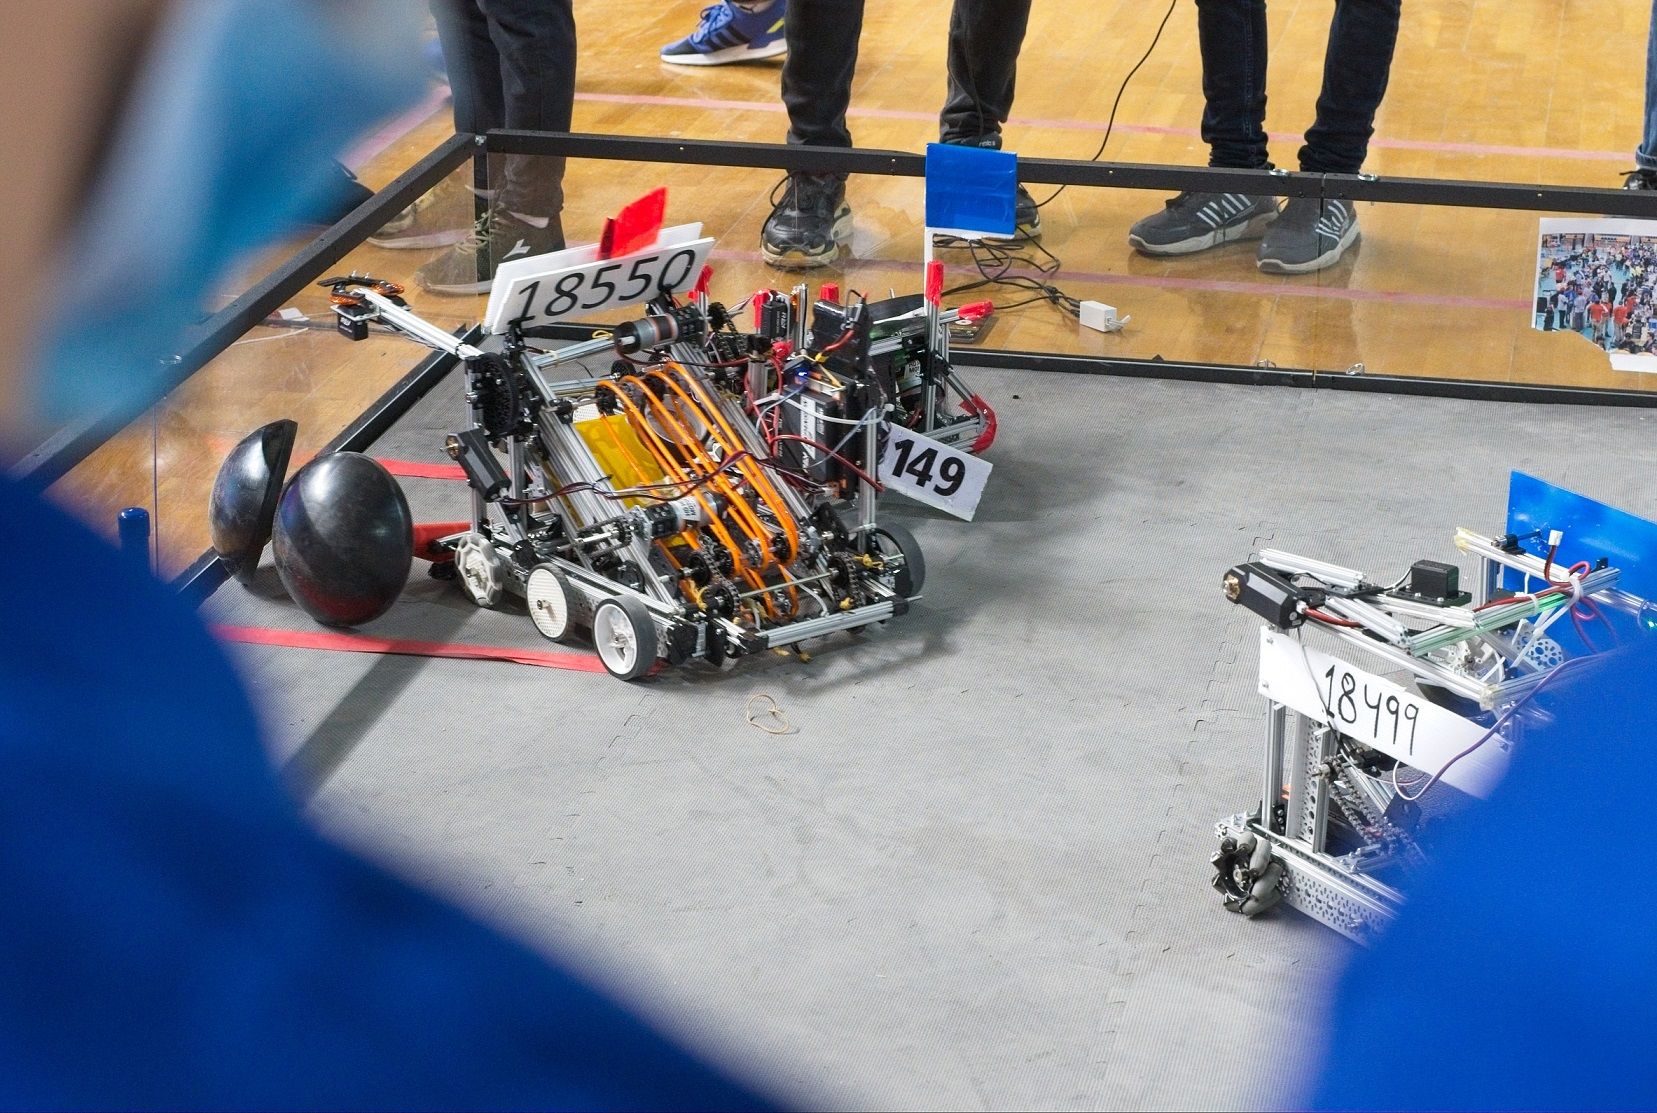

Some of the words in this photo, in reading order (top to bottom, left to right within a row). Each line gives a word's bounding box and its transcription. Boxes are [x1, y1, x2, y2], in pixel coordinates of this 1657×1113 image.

[508, 249, 696, 325] 18550
[891, 438, 966, 497] 149
[1325, 664, 1420, 757] 18499
